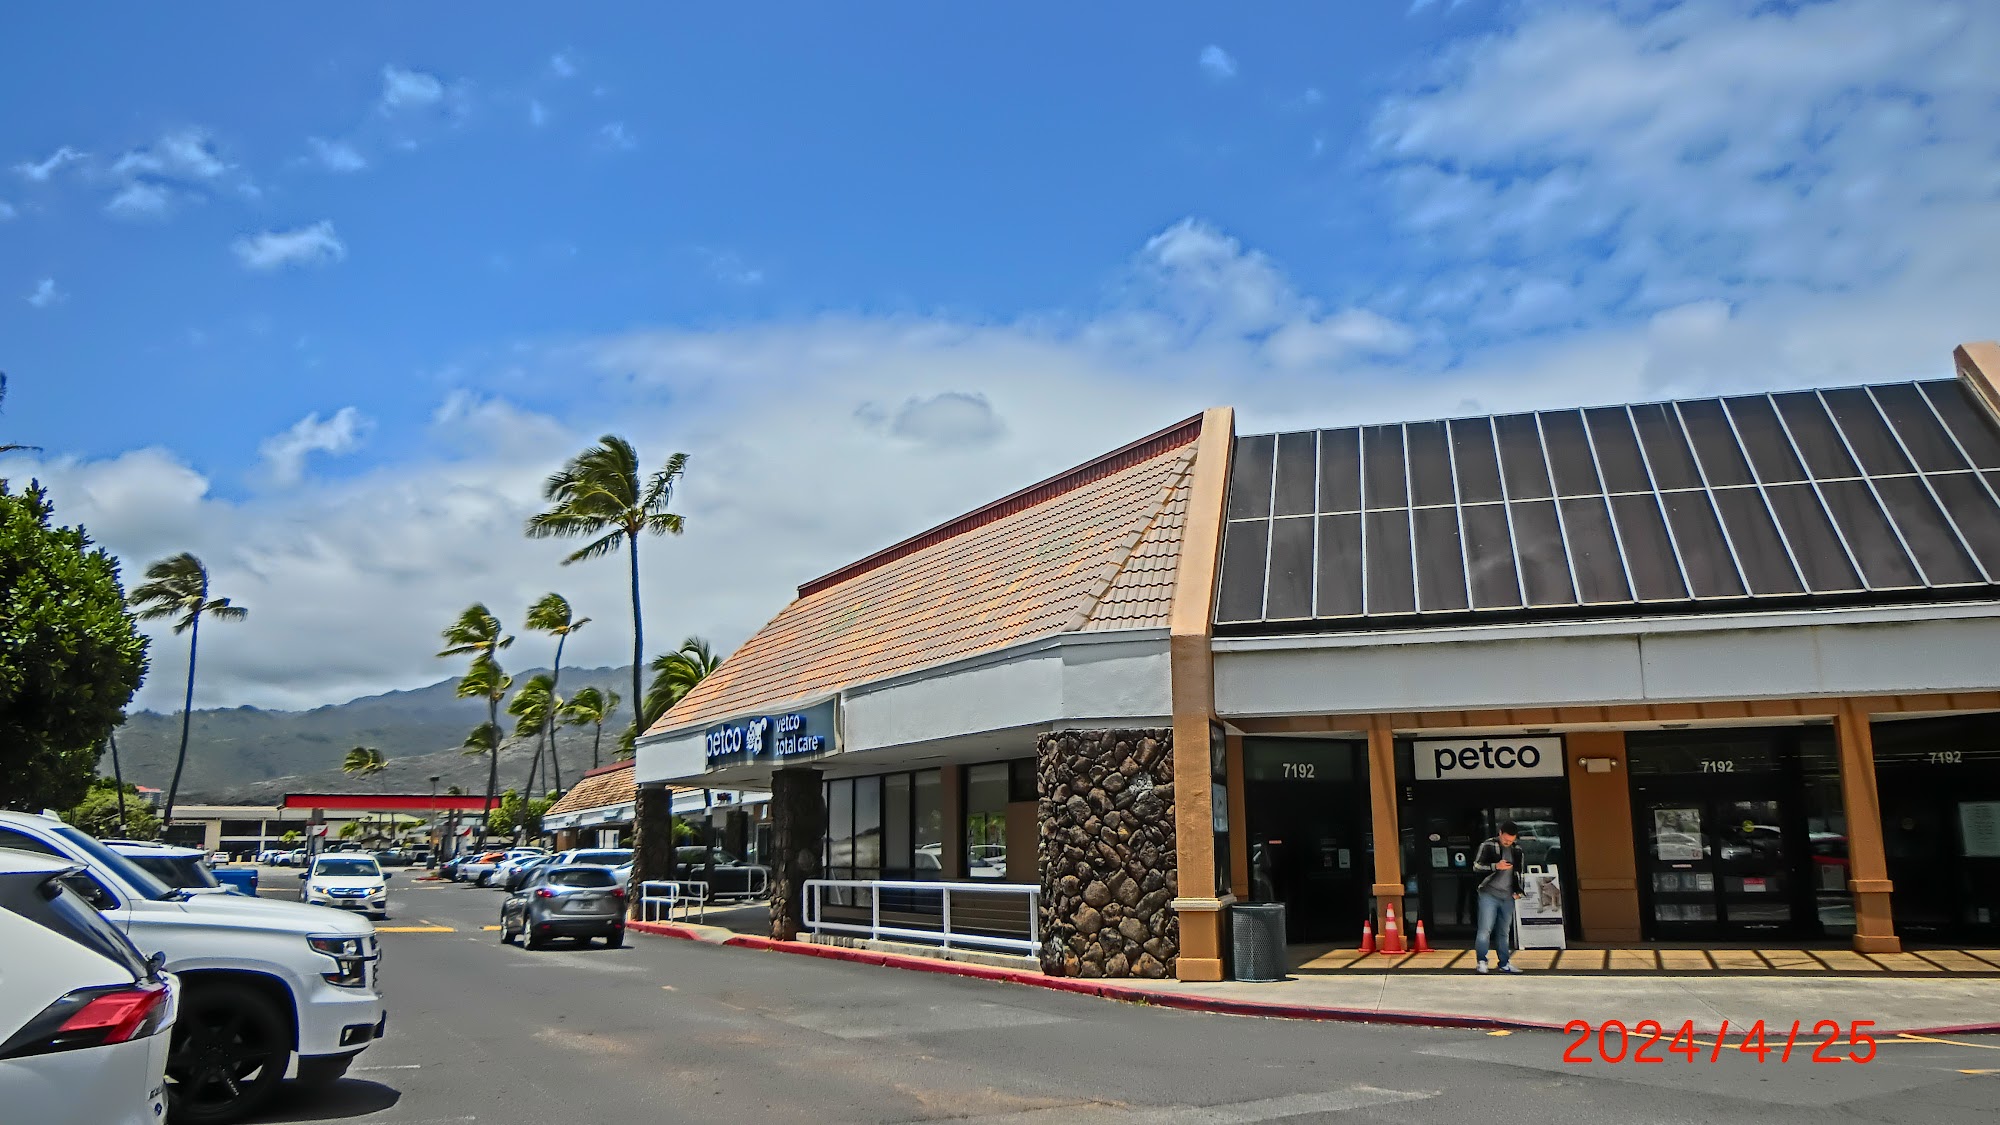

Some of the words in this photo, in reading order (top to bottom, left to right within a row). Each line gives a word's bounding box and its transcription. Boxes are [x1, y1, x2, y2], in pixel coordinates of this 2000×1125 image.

[776, 715, 800, 732] vetco
[706, 725, 742, 757] petco
[775, 734, 796, 756] total
[797, 735, 818, 752] care
[1433, 741, 1540, 778] petco
[1928, 751, 1962, 764] 7192
[1282, 763, 1315, 779] 7192
[1701, 760, 1734, 773] 7192
